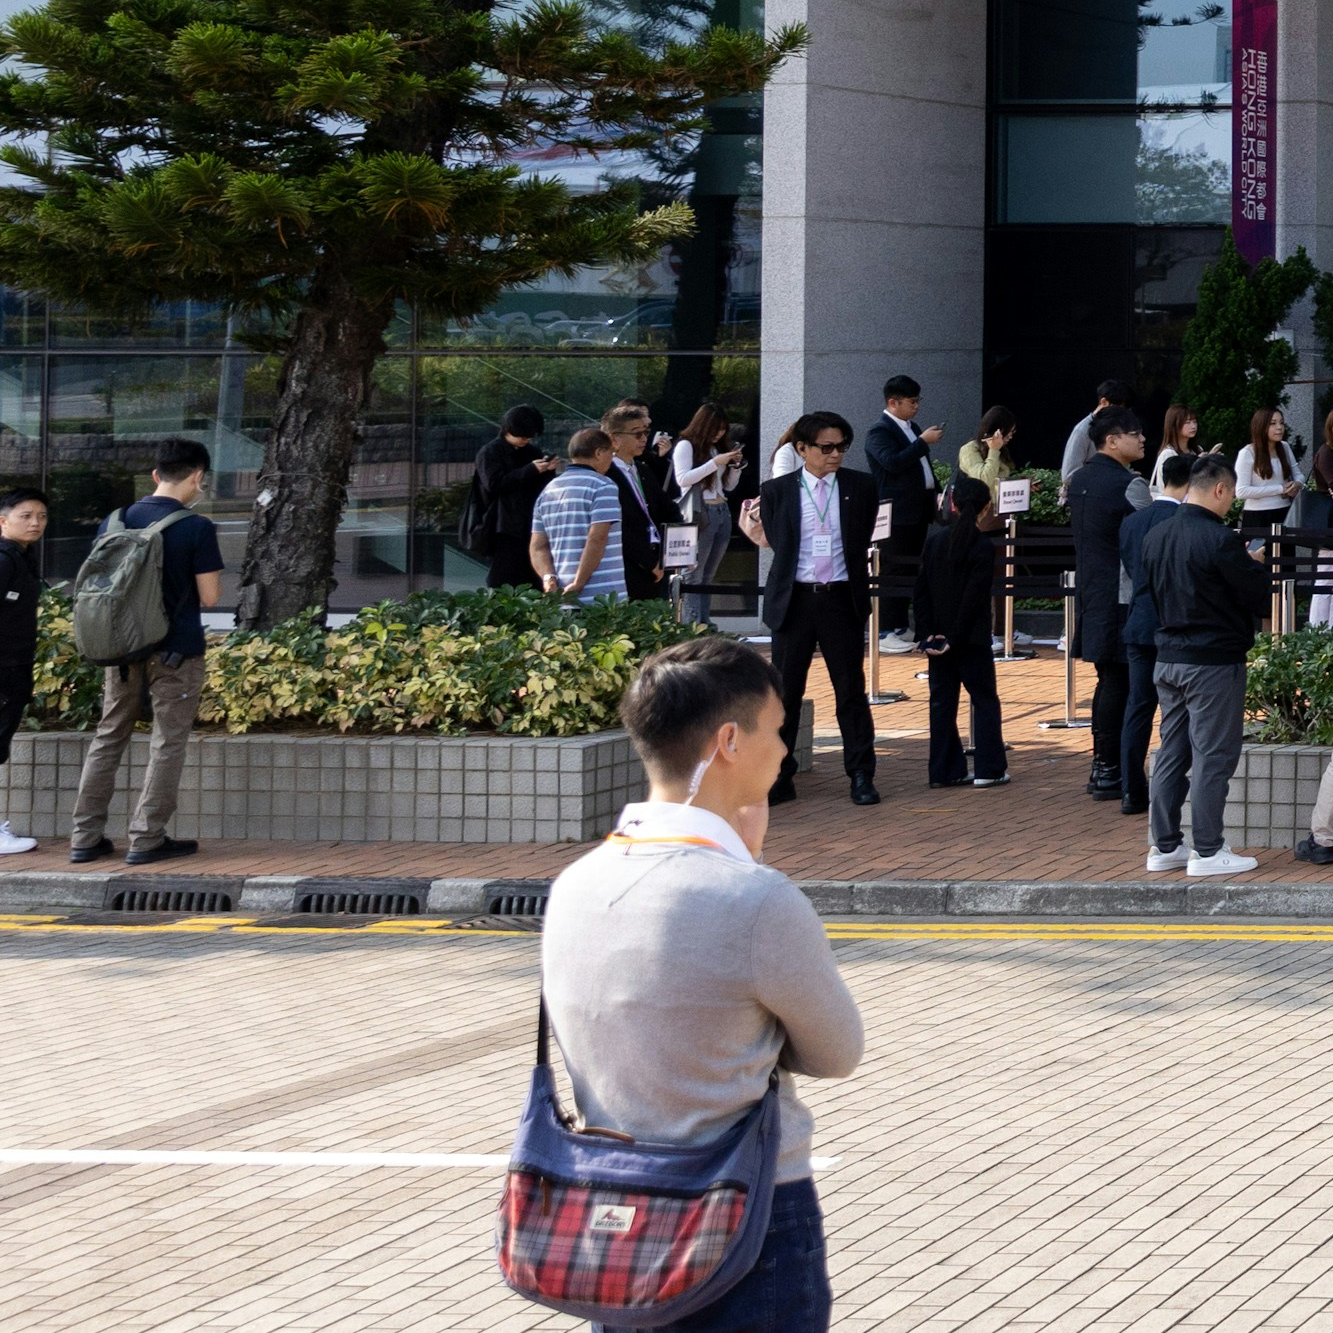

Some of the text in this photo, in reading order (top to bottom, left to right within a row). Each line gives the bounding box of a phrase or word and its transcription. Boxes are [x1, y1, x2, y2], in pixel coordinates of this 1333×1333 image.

[1247, 48, 1257, 220] HONG KONG
[1256, 50, 1268, 221] 香港亞洲國際都會
